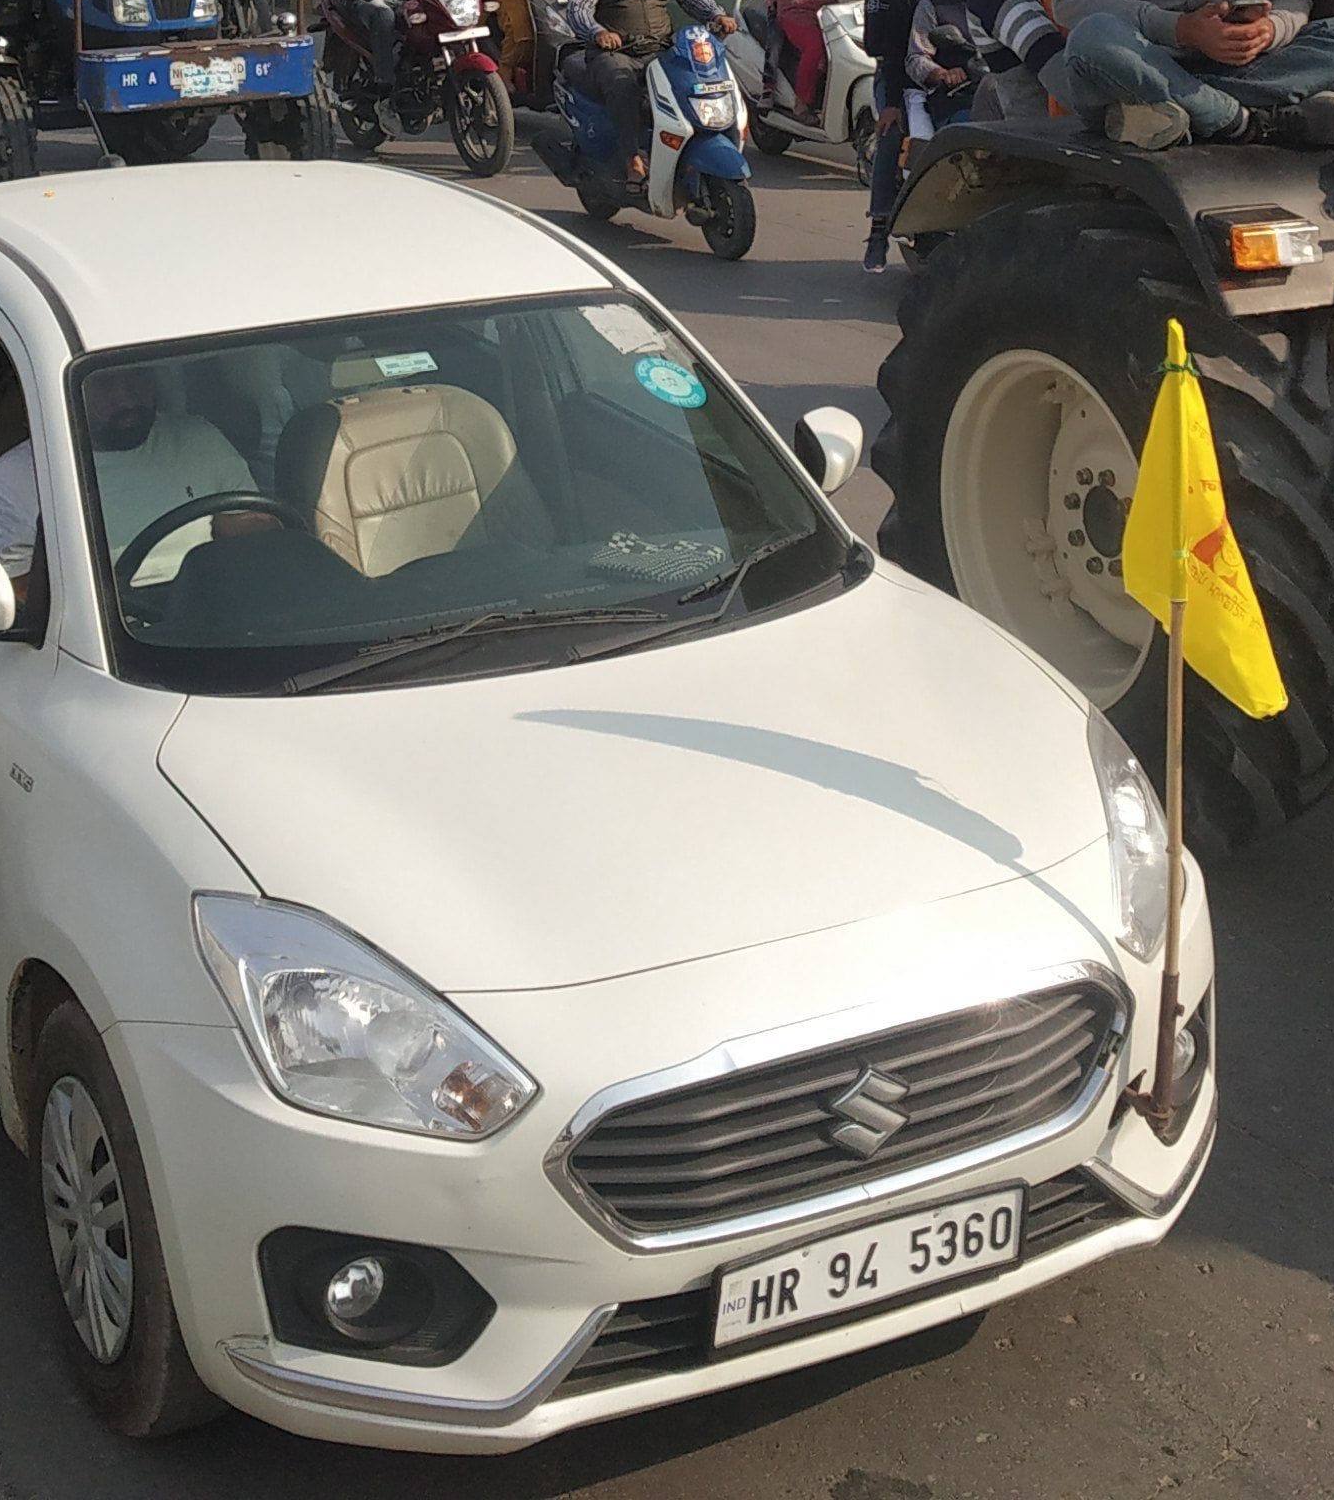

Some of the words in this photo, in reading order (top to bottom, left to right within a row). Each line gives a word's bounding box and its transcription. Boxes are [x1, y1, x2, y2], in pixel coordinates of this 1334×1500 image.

[122, 73, 139, 87] HR
[747, 1267, 800, 1325] HR
[827, 1242, 879, 1299] 94
[909, 1206, 1013, 1274] 5360
[722, 1296, 746, 1315] IND
